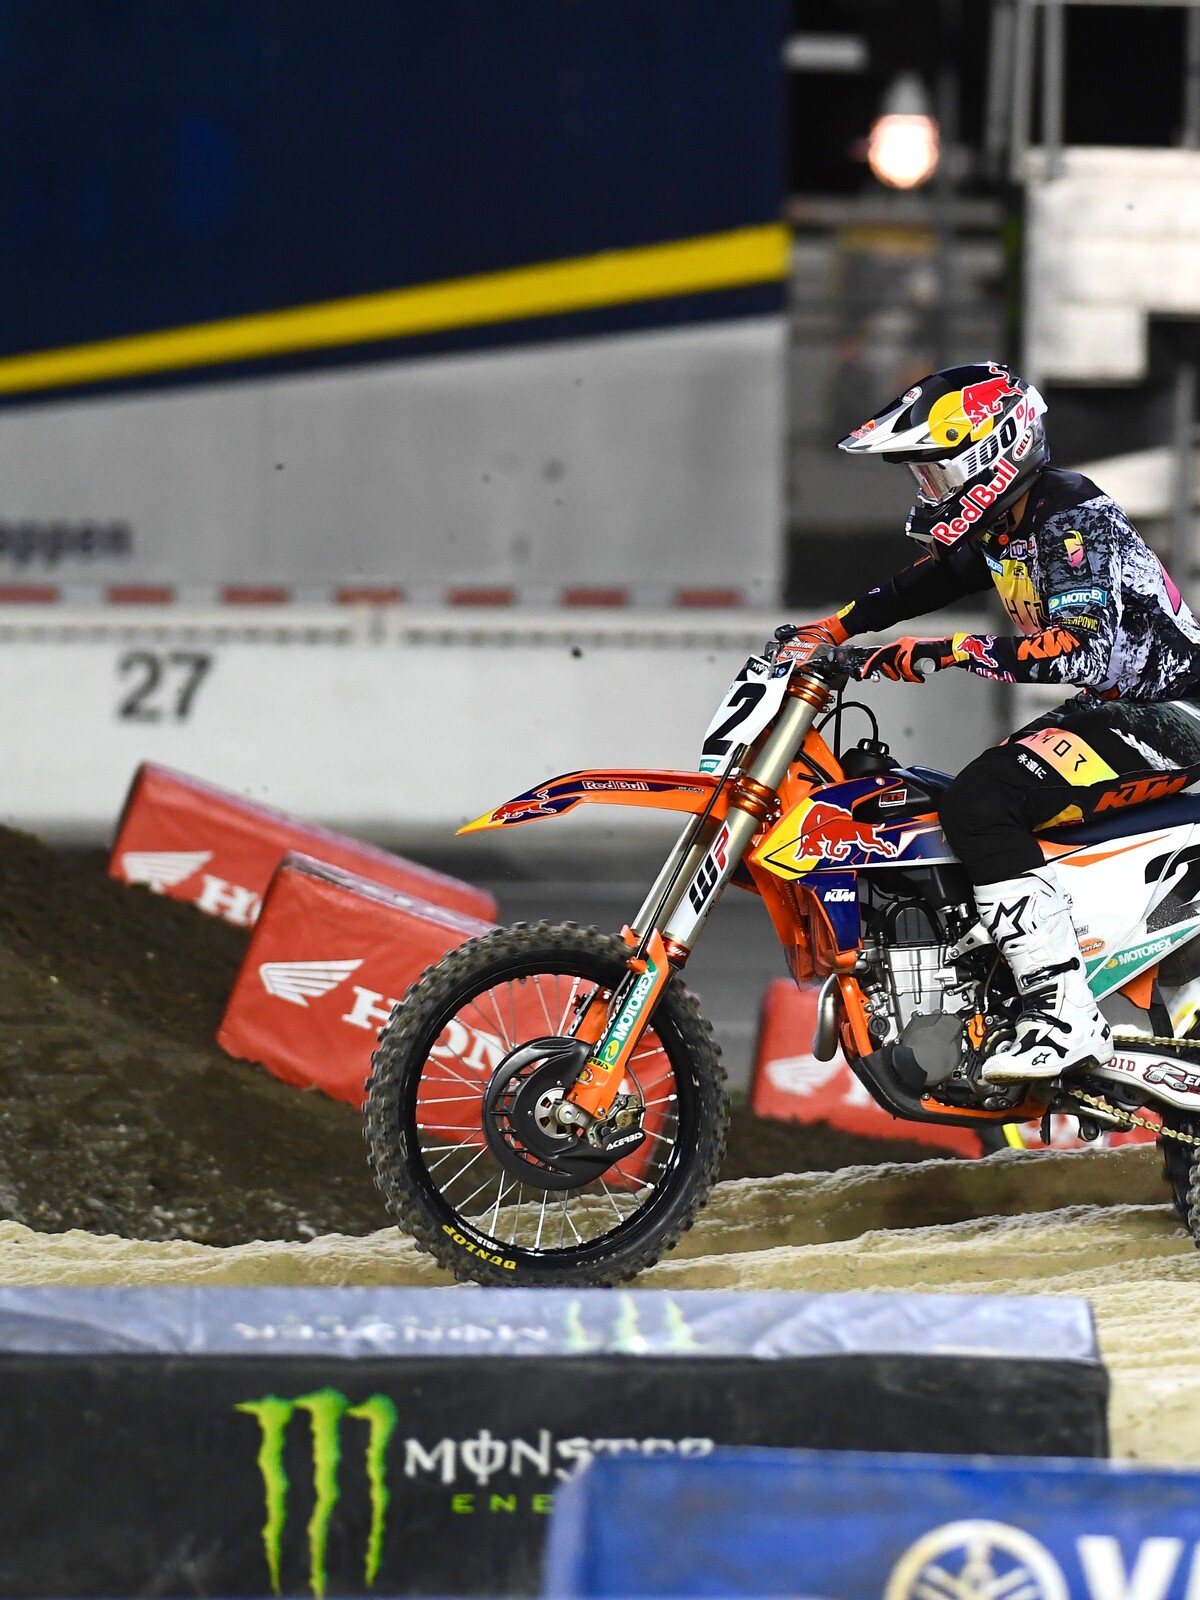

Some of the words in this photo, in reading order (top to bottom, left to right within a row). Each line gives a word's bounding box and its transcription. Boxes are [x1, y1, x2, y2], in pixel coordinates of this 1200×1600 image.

[962, 397, 1036, 477] 100%
[1014, 432, 1033, 457] BELL
[930, 494, 983, 546] Red
[966, 458, 1019, 510] Bull
[1017, 628, 1080, 661] KTM
[116, 650, 213, 725] 27
[702, 682, 767, 756] 2
[582, 780, 615, 790] Red
[616, 781, 649, 791] Bull
[1093, 775, 1188, 812] KTM
[824, 888, 855, 902] KTM
[1117, 937, 1172, 967] MOTOREX
[612, 965, 658, 1042] MOTOREX
[1107, 1057, 1136, 1073] DID
[606, 1131, 643, 1151] ACERBIS
[442, 1224, 517, 1270] DUNLOP
